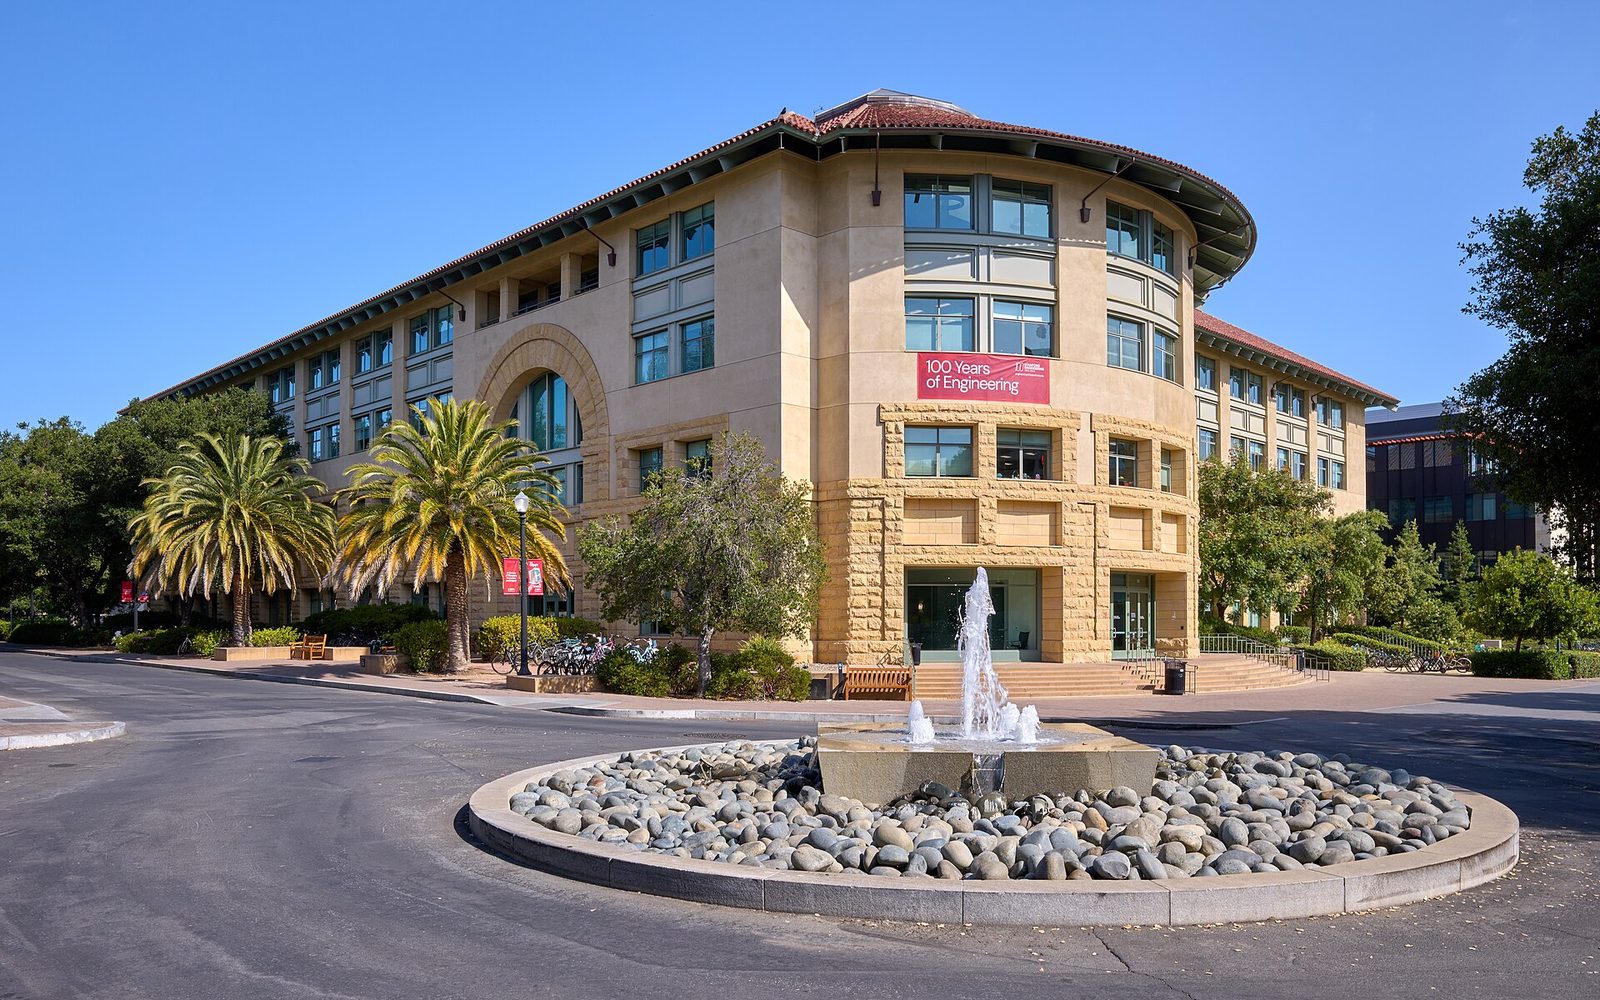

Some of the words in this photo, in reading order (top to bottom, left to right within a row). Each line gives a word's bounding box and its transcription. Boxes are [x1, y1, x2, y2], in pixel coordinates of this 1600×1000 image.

[926, 360, 952, 373] 100
[955, 361, 990, 375] Years
[926, 375, 940, 388] of
[943, 375, 1019, 395] Engineering
